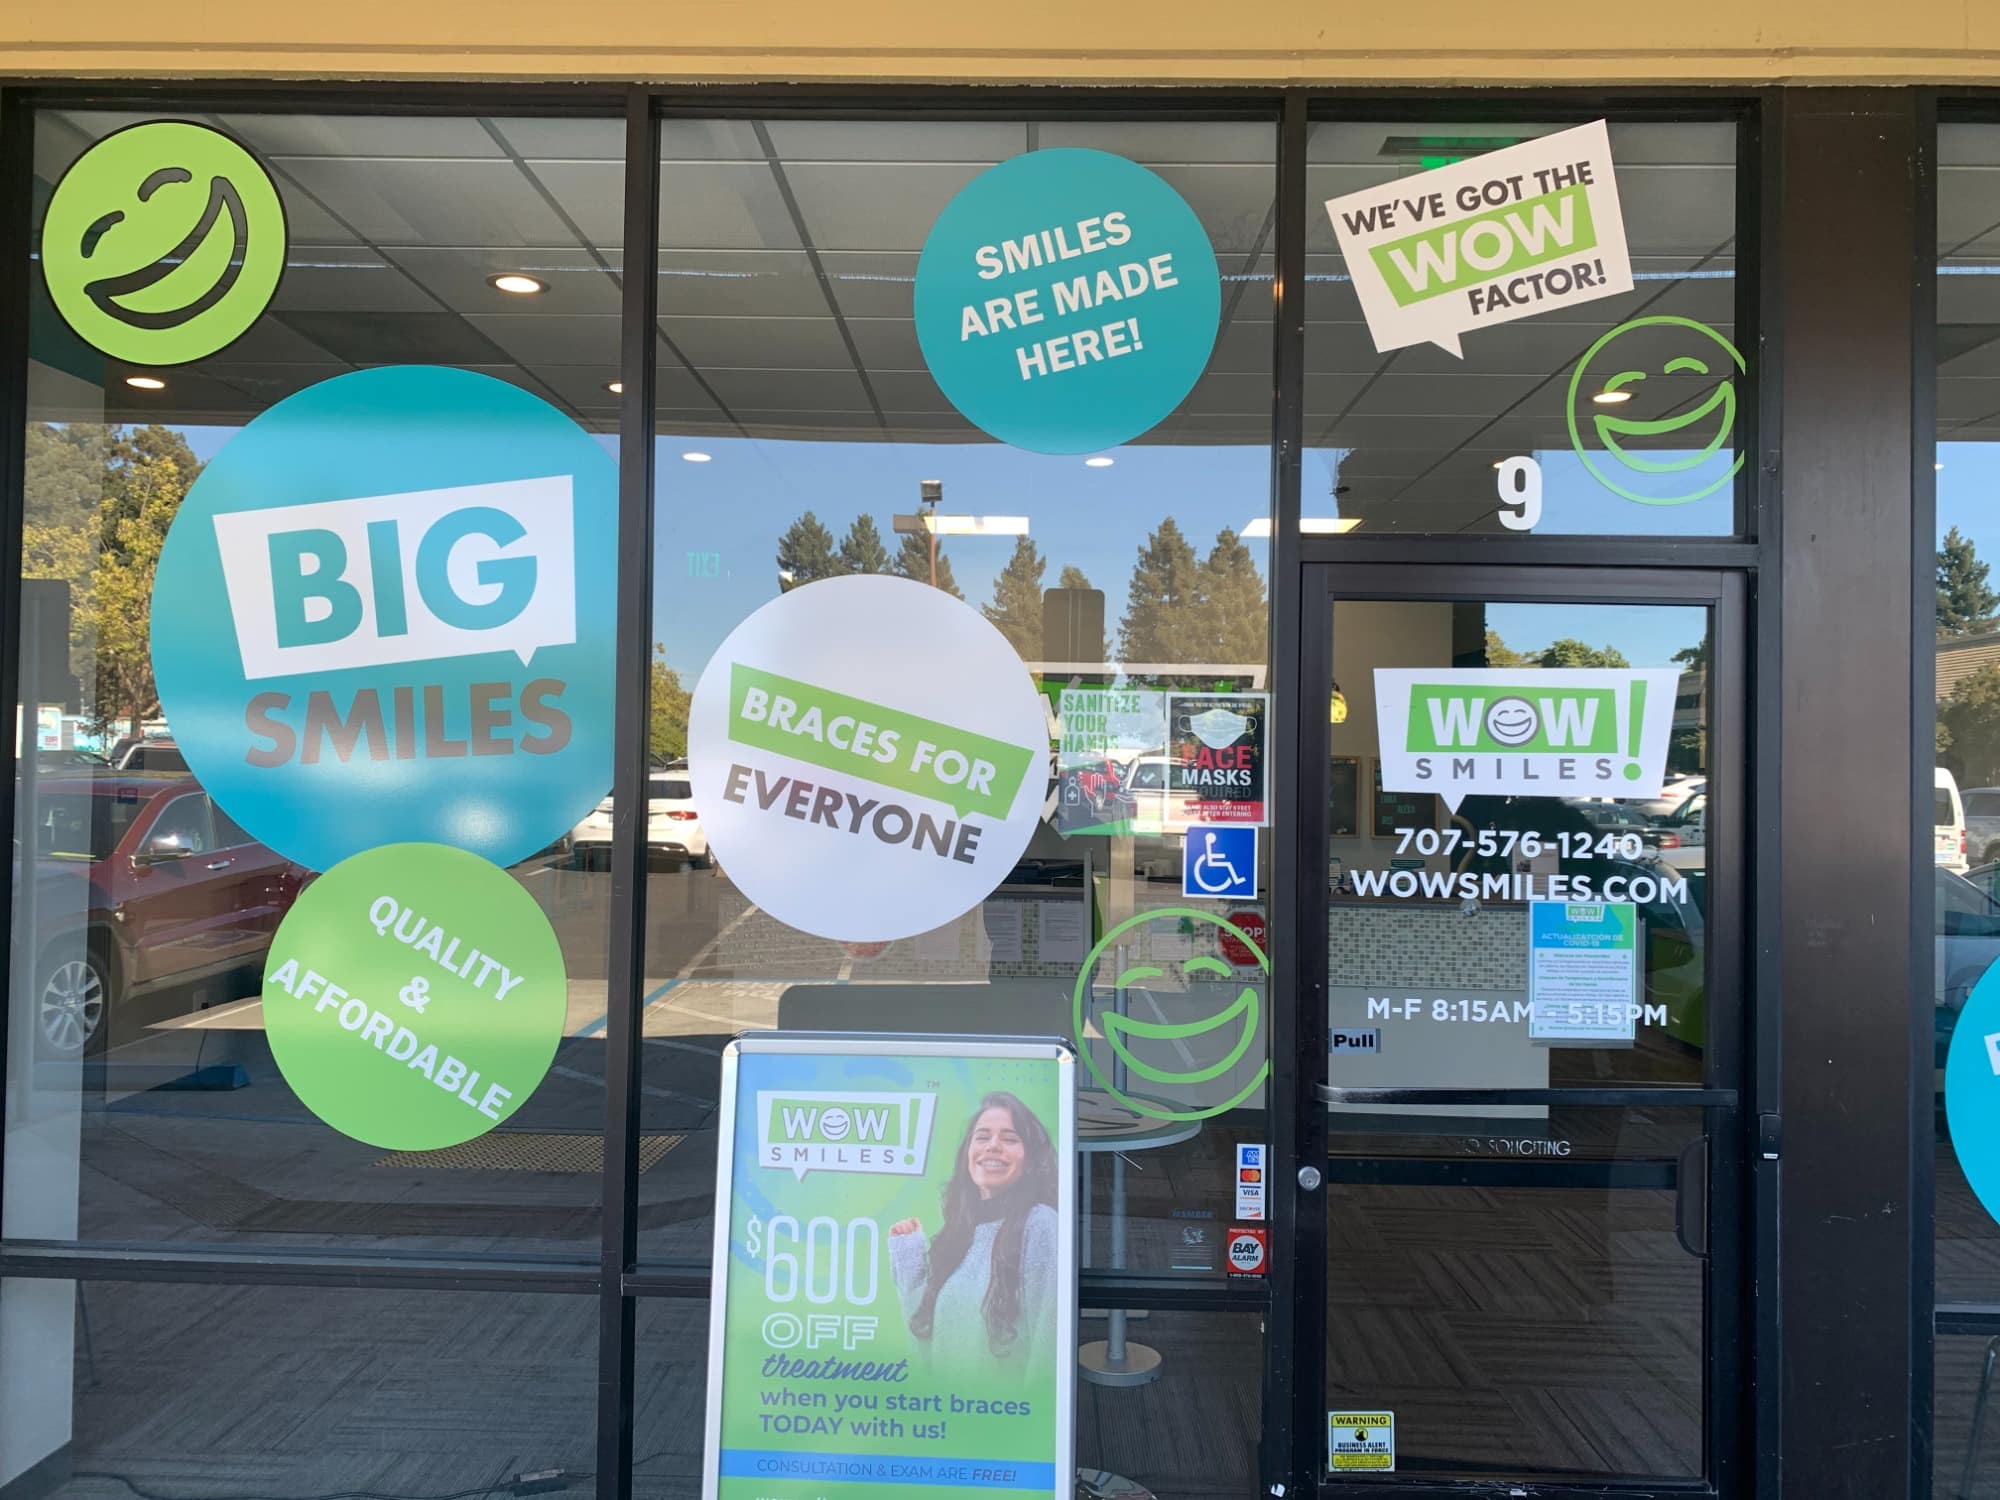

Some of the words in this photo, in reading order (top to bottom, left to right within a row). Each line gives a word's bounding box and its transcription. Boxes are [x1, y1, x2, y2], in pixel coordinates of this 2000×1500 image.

[1341, 195, 1447, 237] WE'VE
[1455, 174, 1525, 212] GOT
[1533, 161, 1595, 196] THE
[975, 211, 1132, 280] SMILES
[1388, 195, 1577, 293] WOW
[960, 288, 1043, 341] ARE
[1052, 253, 1179, 316] MADE
[1468, 258, 1607, 316] FACTOR!
[1015, 318, 1143, 381] HERE!
[1496, 456, 1542, 531] 9
[267, 505, 538, 649] BIG
[244, 678, 573, 767] SMILES
[1063, 694, 1141, 713] SANITIZE
[1063, 714, 1107, 732] YOUR
[1426, 697, 1599, 748] WOW
[740, 687, 901, 763] BRACES
[909, 740, 996, 796] FOR
[1182, 769, 1252, 786] MASKS
[1415, 758, 1612, 780] SMILES
[723, 763, 982, 864] EVERYONE
[1394, 828, 1643, 860] 707-576-1240
[1350, 870, 1688, 905] WOWSMILES.COM
[369, 895, 525, 1001] QUALITY
[399, 974, 432, 1014] &
[1367, 997, 1421, 1021] M-F
[1432, 999, 1535, 1024] 8:15AM
[1567, 1002, 1668, 1027] 5:15PM
[268, 959, 512, 1120] AFFORDABLE
[1333, 1033, 1375, 1048] Pull
[781, 1106, 890, 1142] WOW
[771, 1147, 895, 1165] SMILES
[746, 1214, 879, 1305] $600
[1232, 1243, 1259, 1254] BAY
[761, 1312, 879, 1351] OFF
[761, 1353, 910, 1382] treatment
[760, 1389, 828, 1409] when
[835, 1393, 879, 1412] you
[886, 1393, 942, 1412] start
[950, 1394, 1031, 1416] braces
[1335, 1416, 1387, 1425] WARNING
[759, 1414, 843, 1435] TODAY
[850, 1417, 904, 1438] with
[913, 1421, 947, 1440] us!
[757, 1459, 873, 1477] CONSULTATION
[876, 1465, 887, 1477] &
[891, 1465, 933, 1479] EXAM
[936, 1467, 968, 1480] ARE
[971, 1468, 1017, 1482] FREE!
